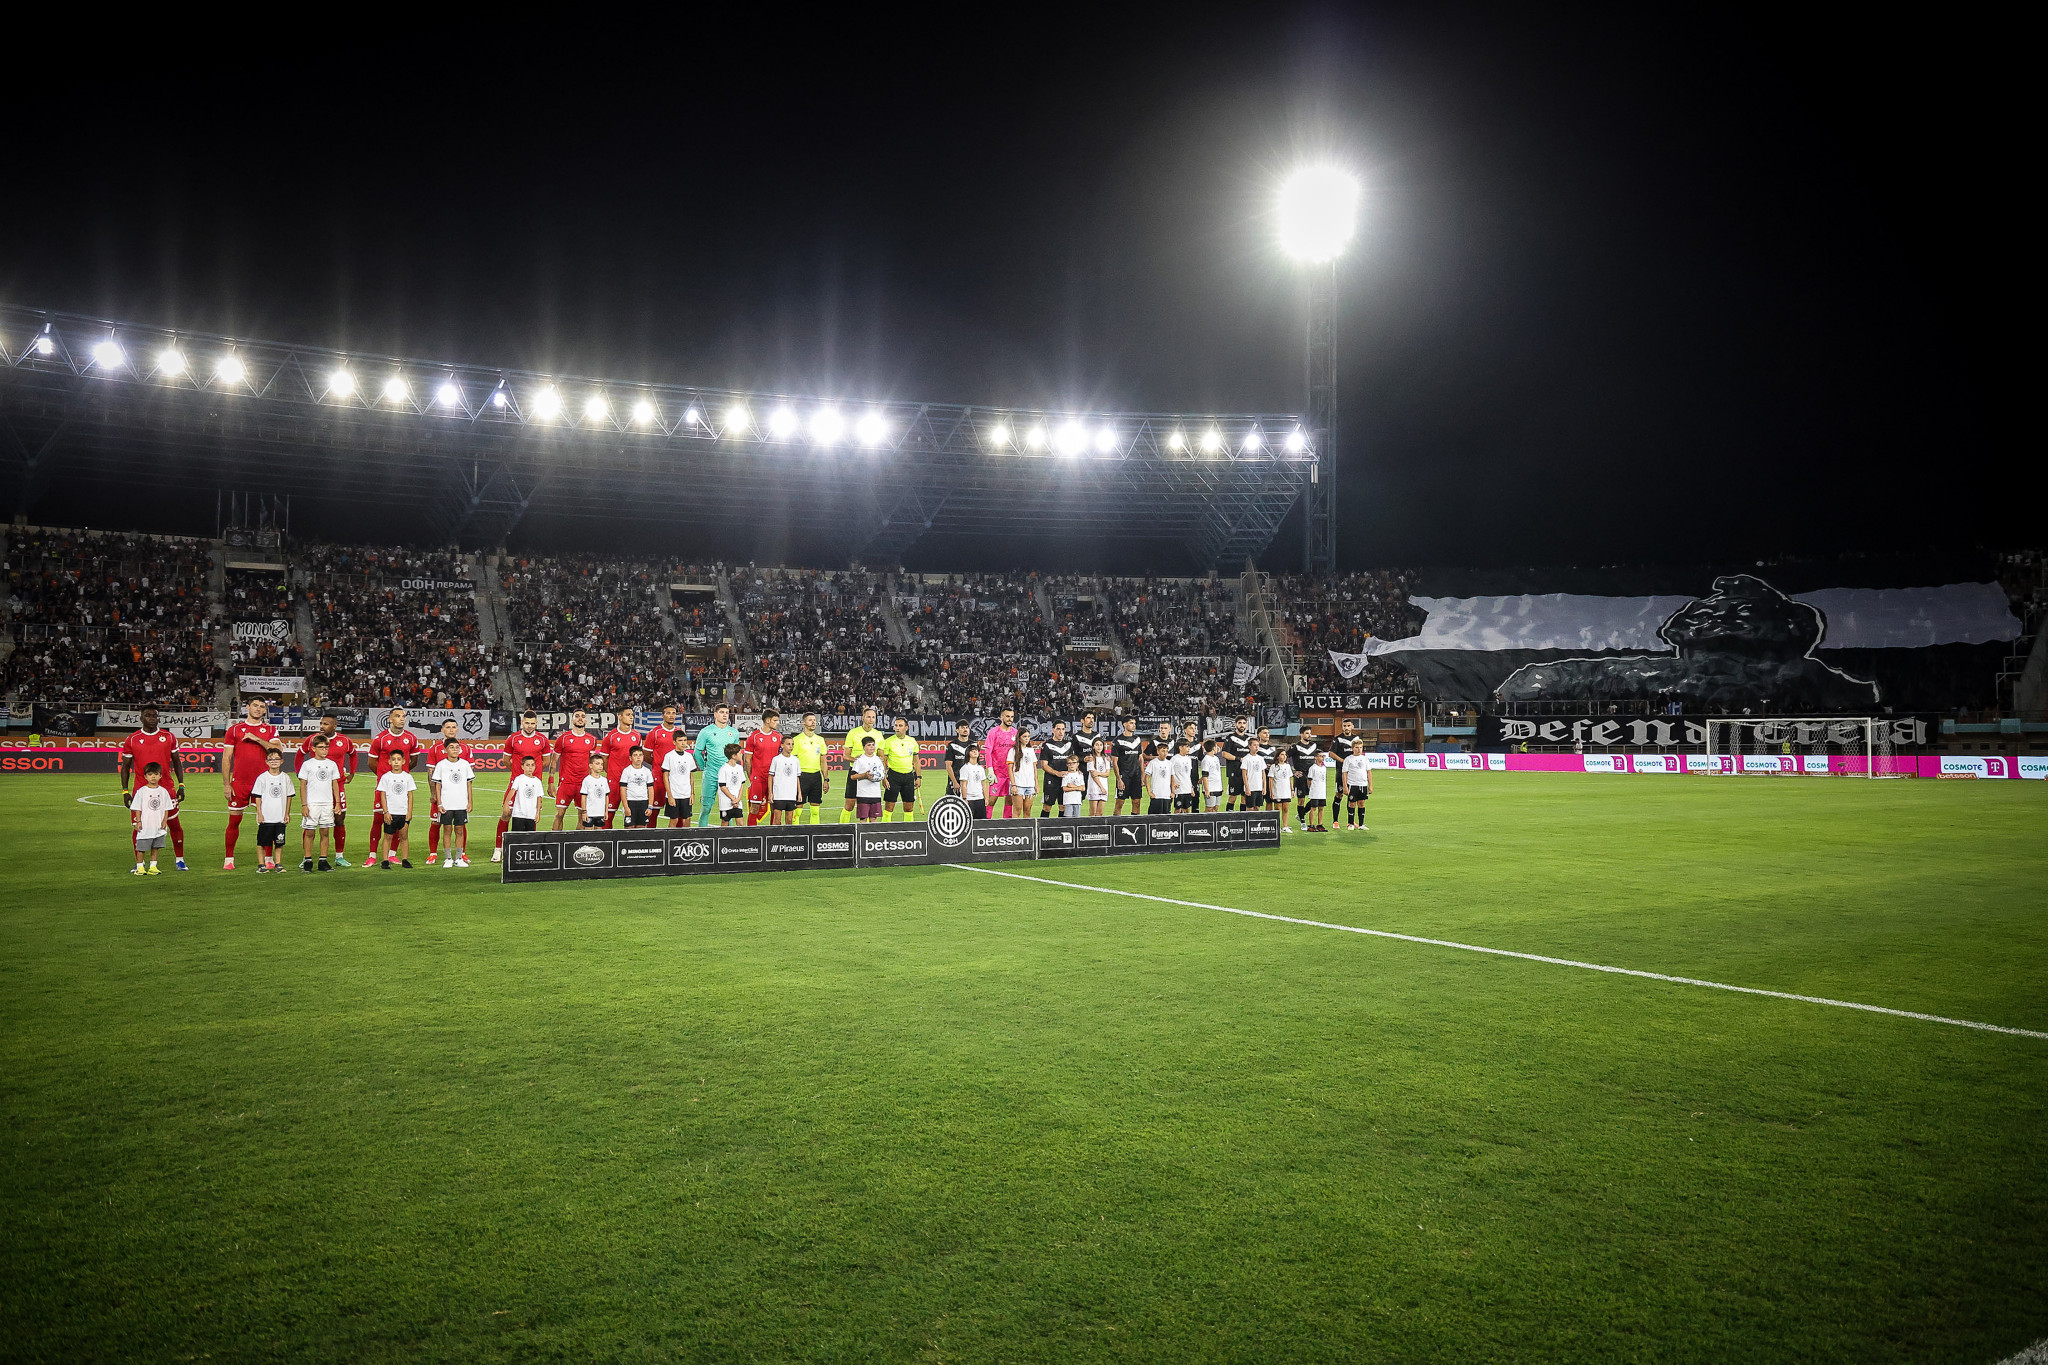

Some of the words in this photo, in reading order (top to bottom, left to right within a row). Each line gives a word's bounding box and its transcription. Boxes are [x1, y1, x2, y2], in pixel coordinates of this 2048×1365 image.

[402, 579, 434, 589] ΟΦΗ
[236, 622, 270, 636] ΜΟΝΟ
[1368, 696, 1420, 709] ANES
[833, 715, 889, 729] MASTAS
[1500, 718, 1707, 746] Defend
[0, 758, 64, 770] sson
[1152, 829, 1179, 838] Europa
[865, 839, 922, 851] betsson
[977, 835, 1029, 846] betsson
[673, 843, 710, 857] ZARO'S
[779, 844, 804, 853] Piraeus
[516, 850, 552, 861] STELLA
